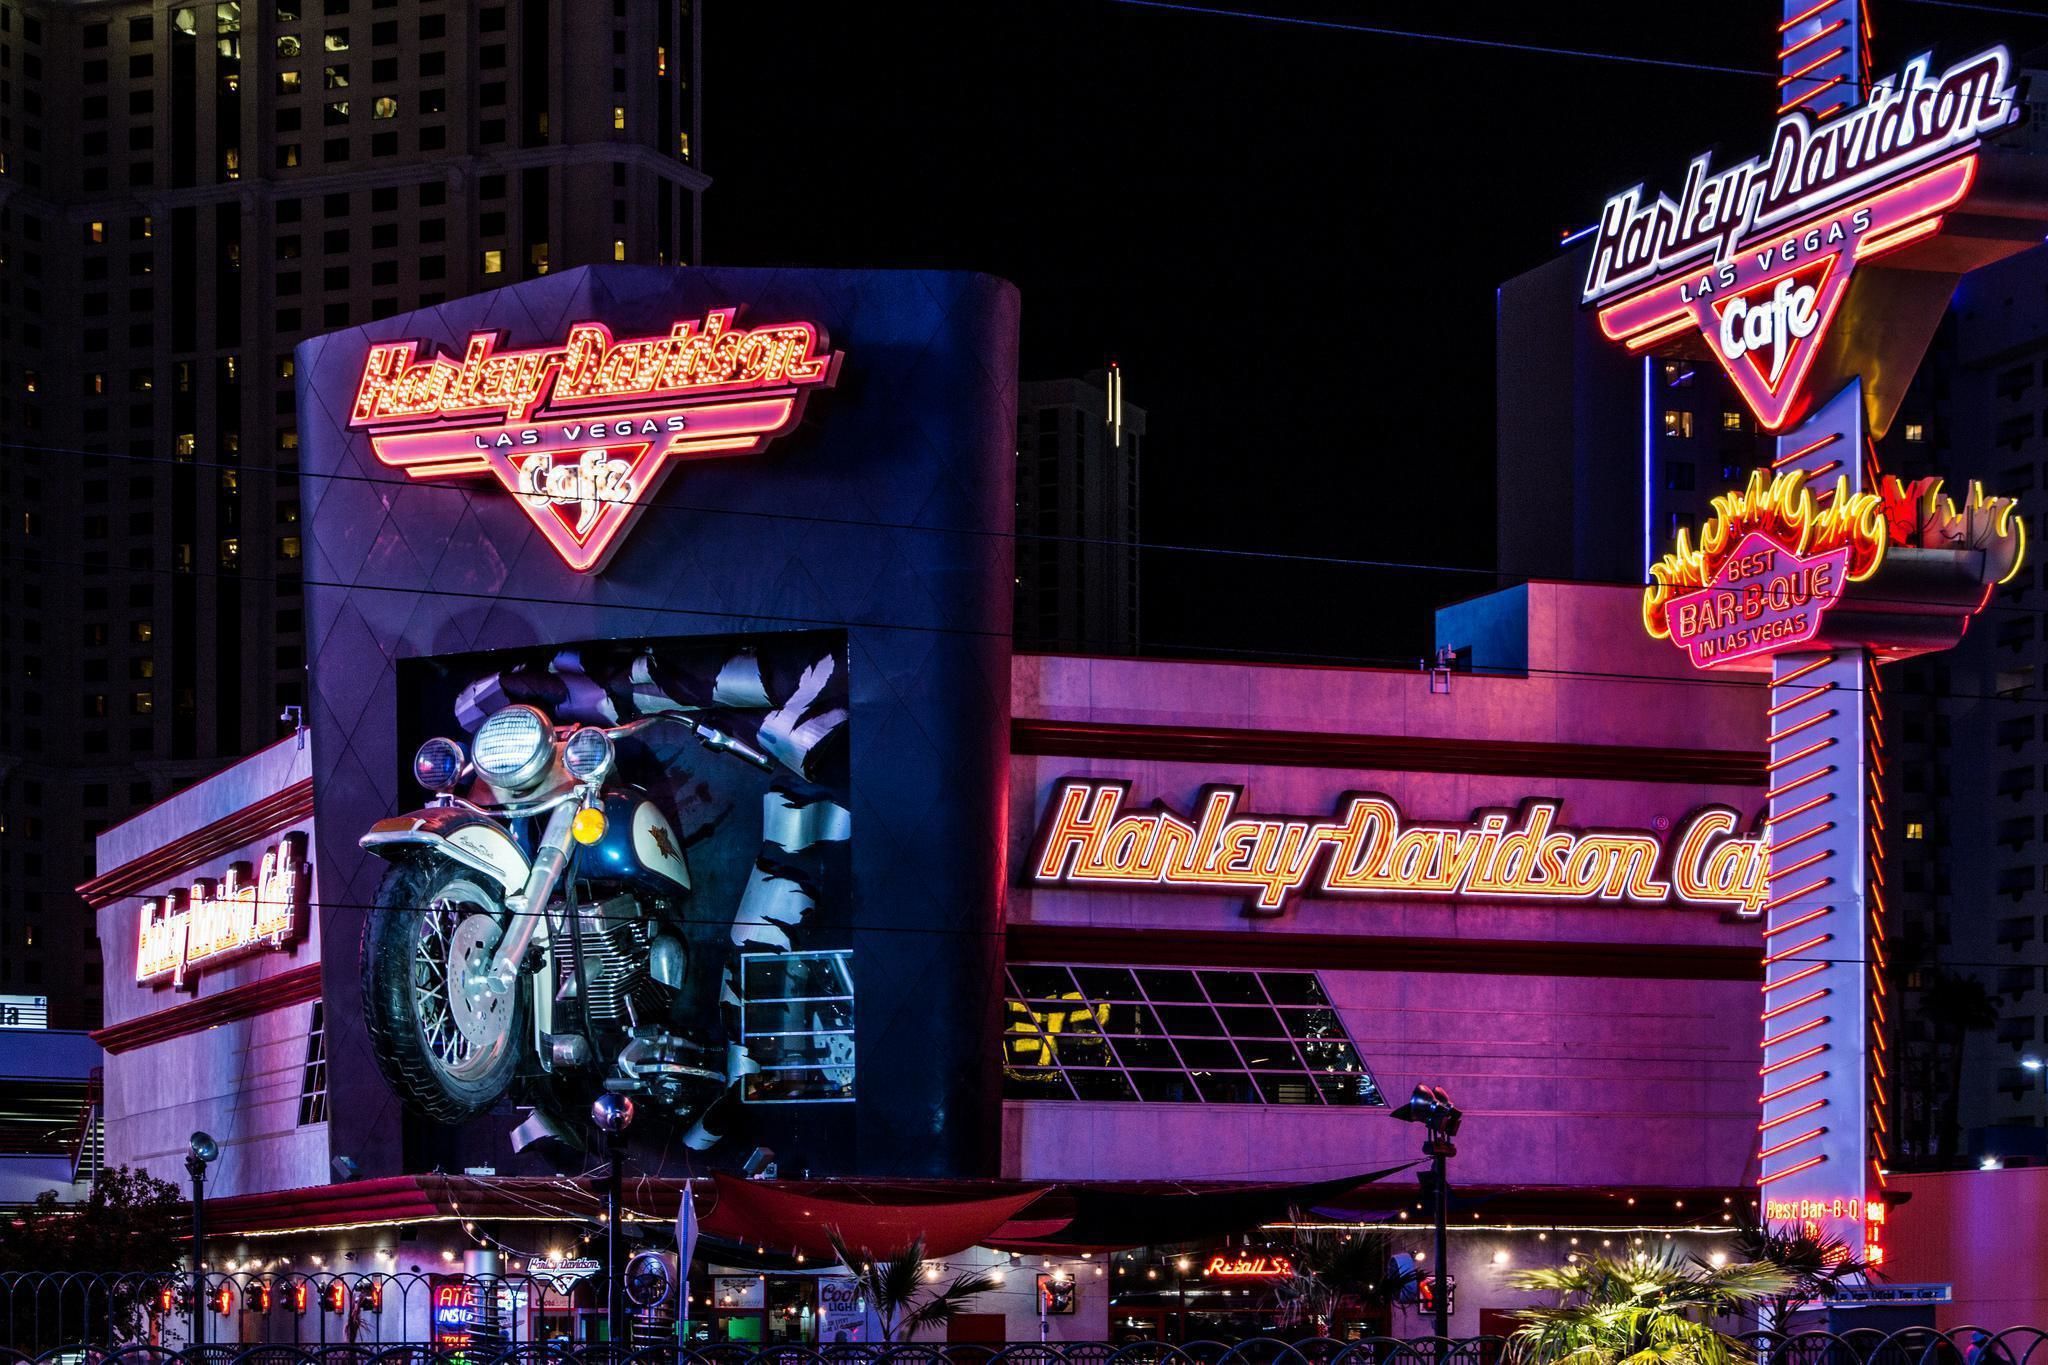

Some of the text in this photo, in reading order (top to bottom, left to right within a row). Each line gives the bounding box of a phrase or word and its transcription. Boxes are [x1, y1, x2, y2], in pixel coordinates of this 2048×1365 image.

[1680, 208, 1872, 304] LAS VEGAS
[1719, 277, 1820, 382] Cafe
[475, 415, 687, 450] LAS VEGAS
[518, 449, 634, 534] Cafe
[1680, 562, 1833, 638] BAR-B-QUE
[1728, 549, 1775, 583] BEST
[1699, 614, 1808, 658] IN LAS VEGAS
[1673, 810, 1770, 914] Caf
[1766, 1200, 1799, 1219] Best
